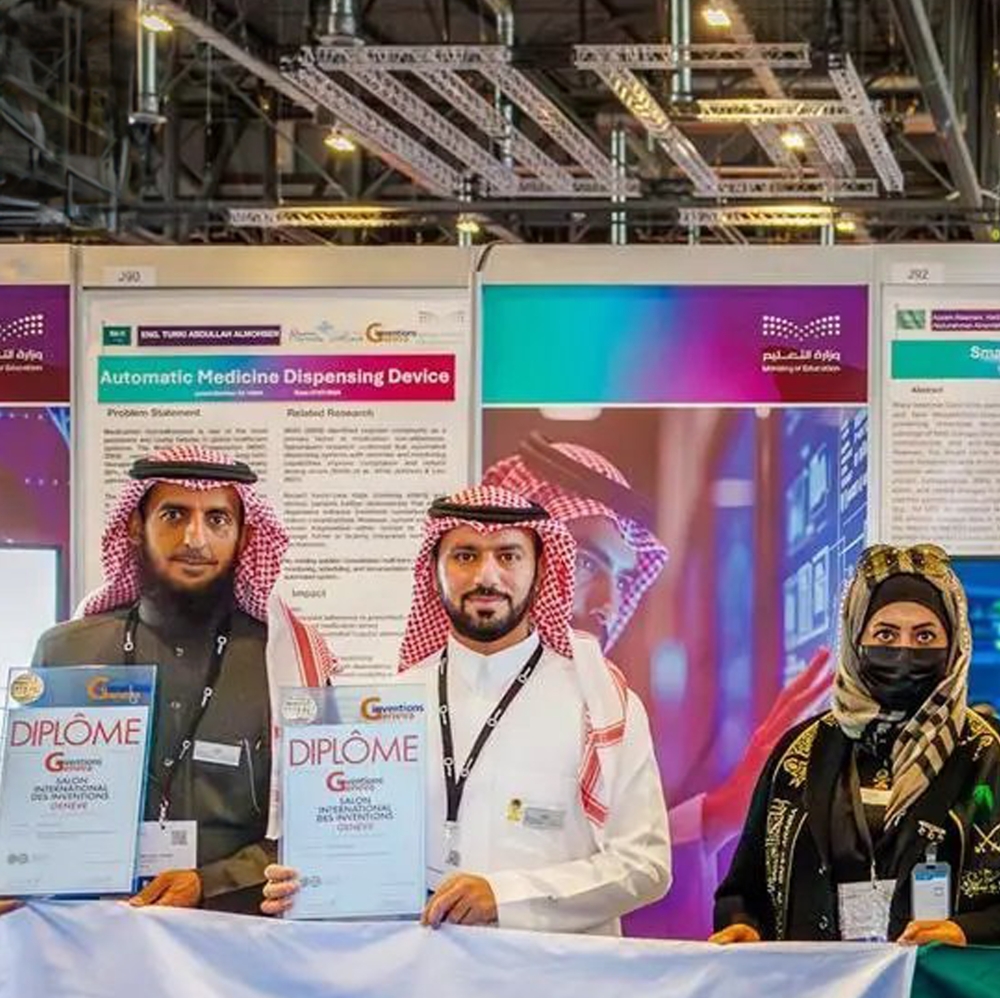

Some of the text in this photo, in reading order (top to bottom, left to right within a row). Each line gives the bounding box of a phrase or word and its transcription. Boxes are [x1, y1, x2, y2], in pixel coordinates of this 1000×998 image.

[100, 368, 450, 387] Automatic Medicine Dispensing Device
[107, 409, 201, 418] Problem Statement
[287, 408, 374, 417] Related Research
[10, 712, 142, 747] DIPLÔME
[289, 729, 419, 767] DIPLÔME
[34, 784, 107, 793] INTERNATIONAL
[31, 792, 109, 802] DES INVENTIONS
[340, 797, 372, 805] SALON
[318, 805, 392, 814] INTERNATIONAL
[316, 812, 394, 822] DES INVENTIONS
